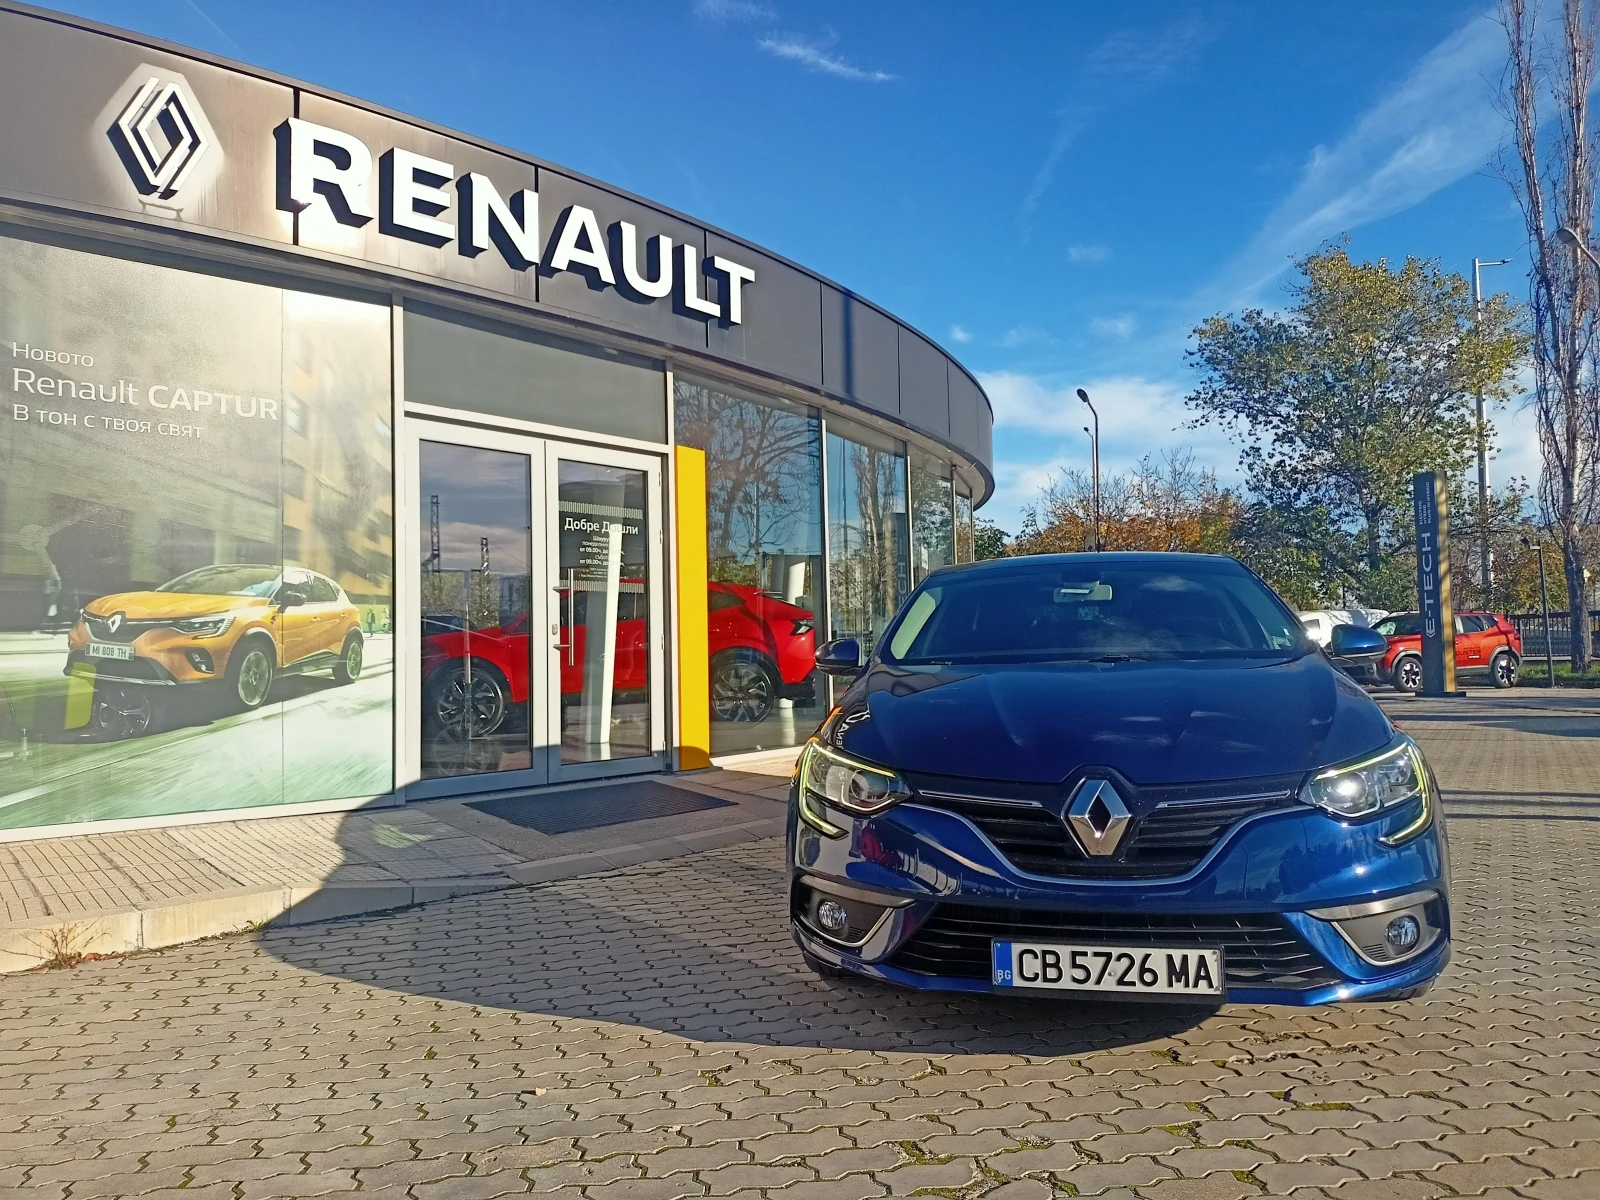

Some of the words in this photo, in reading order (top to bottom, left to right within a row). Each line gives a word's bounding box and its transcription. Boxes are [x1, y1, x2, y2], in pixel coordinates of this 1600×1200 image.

[282, 116, 756, 327] RENAULT
[11, 341, 94, 367] Новото
[12, 367, 139, 406] Renault
[148, 384, 279, 421] CAPTUR
[13, 404, 29, 421] В
[36, 409, 77, 426] тон
[102, 416, 151, 433] твоя
[157, 422, 203, 439] свят
[564, 517, 600, 533] Добре
[601, 520, 639, 535] Дошли
[1421, 532, 1436, 638] E-TECH
[117, 647, 127, 658] TH
[997, 969, 1012, 980] BG
[1017, 948, 1064, 983] CB
[1069, 950, 1160, 987] 5726
[1166, 953, 1215, 989] MA
